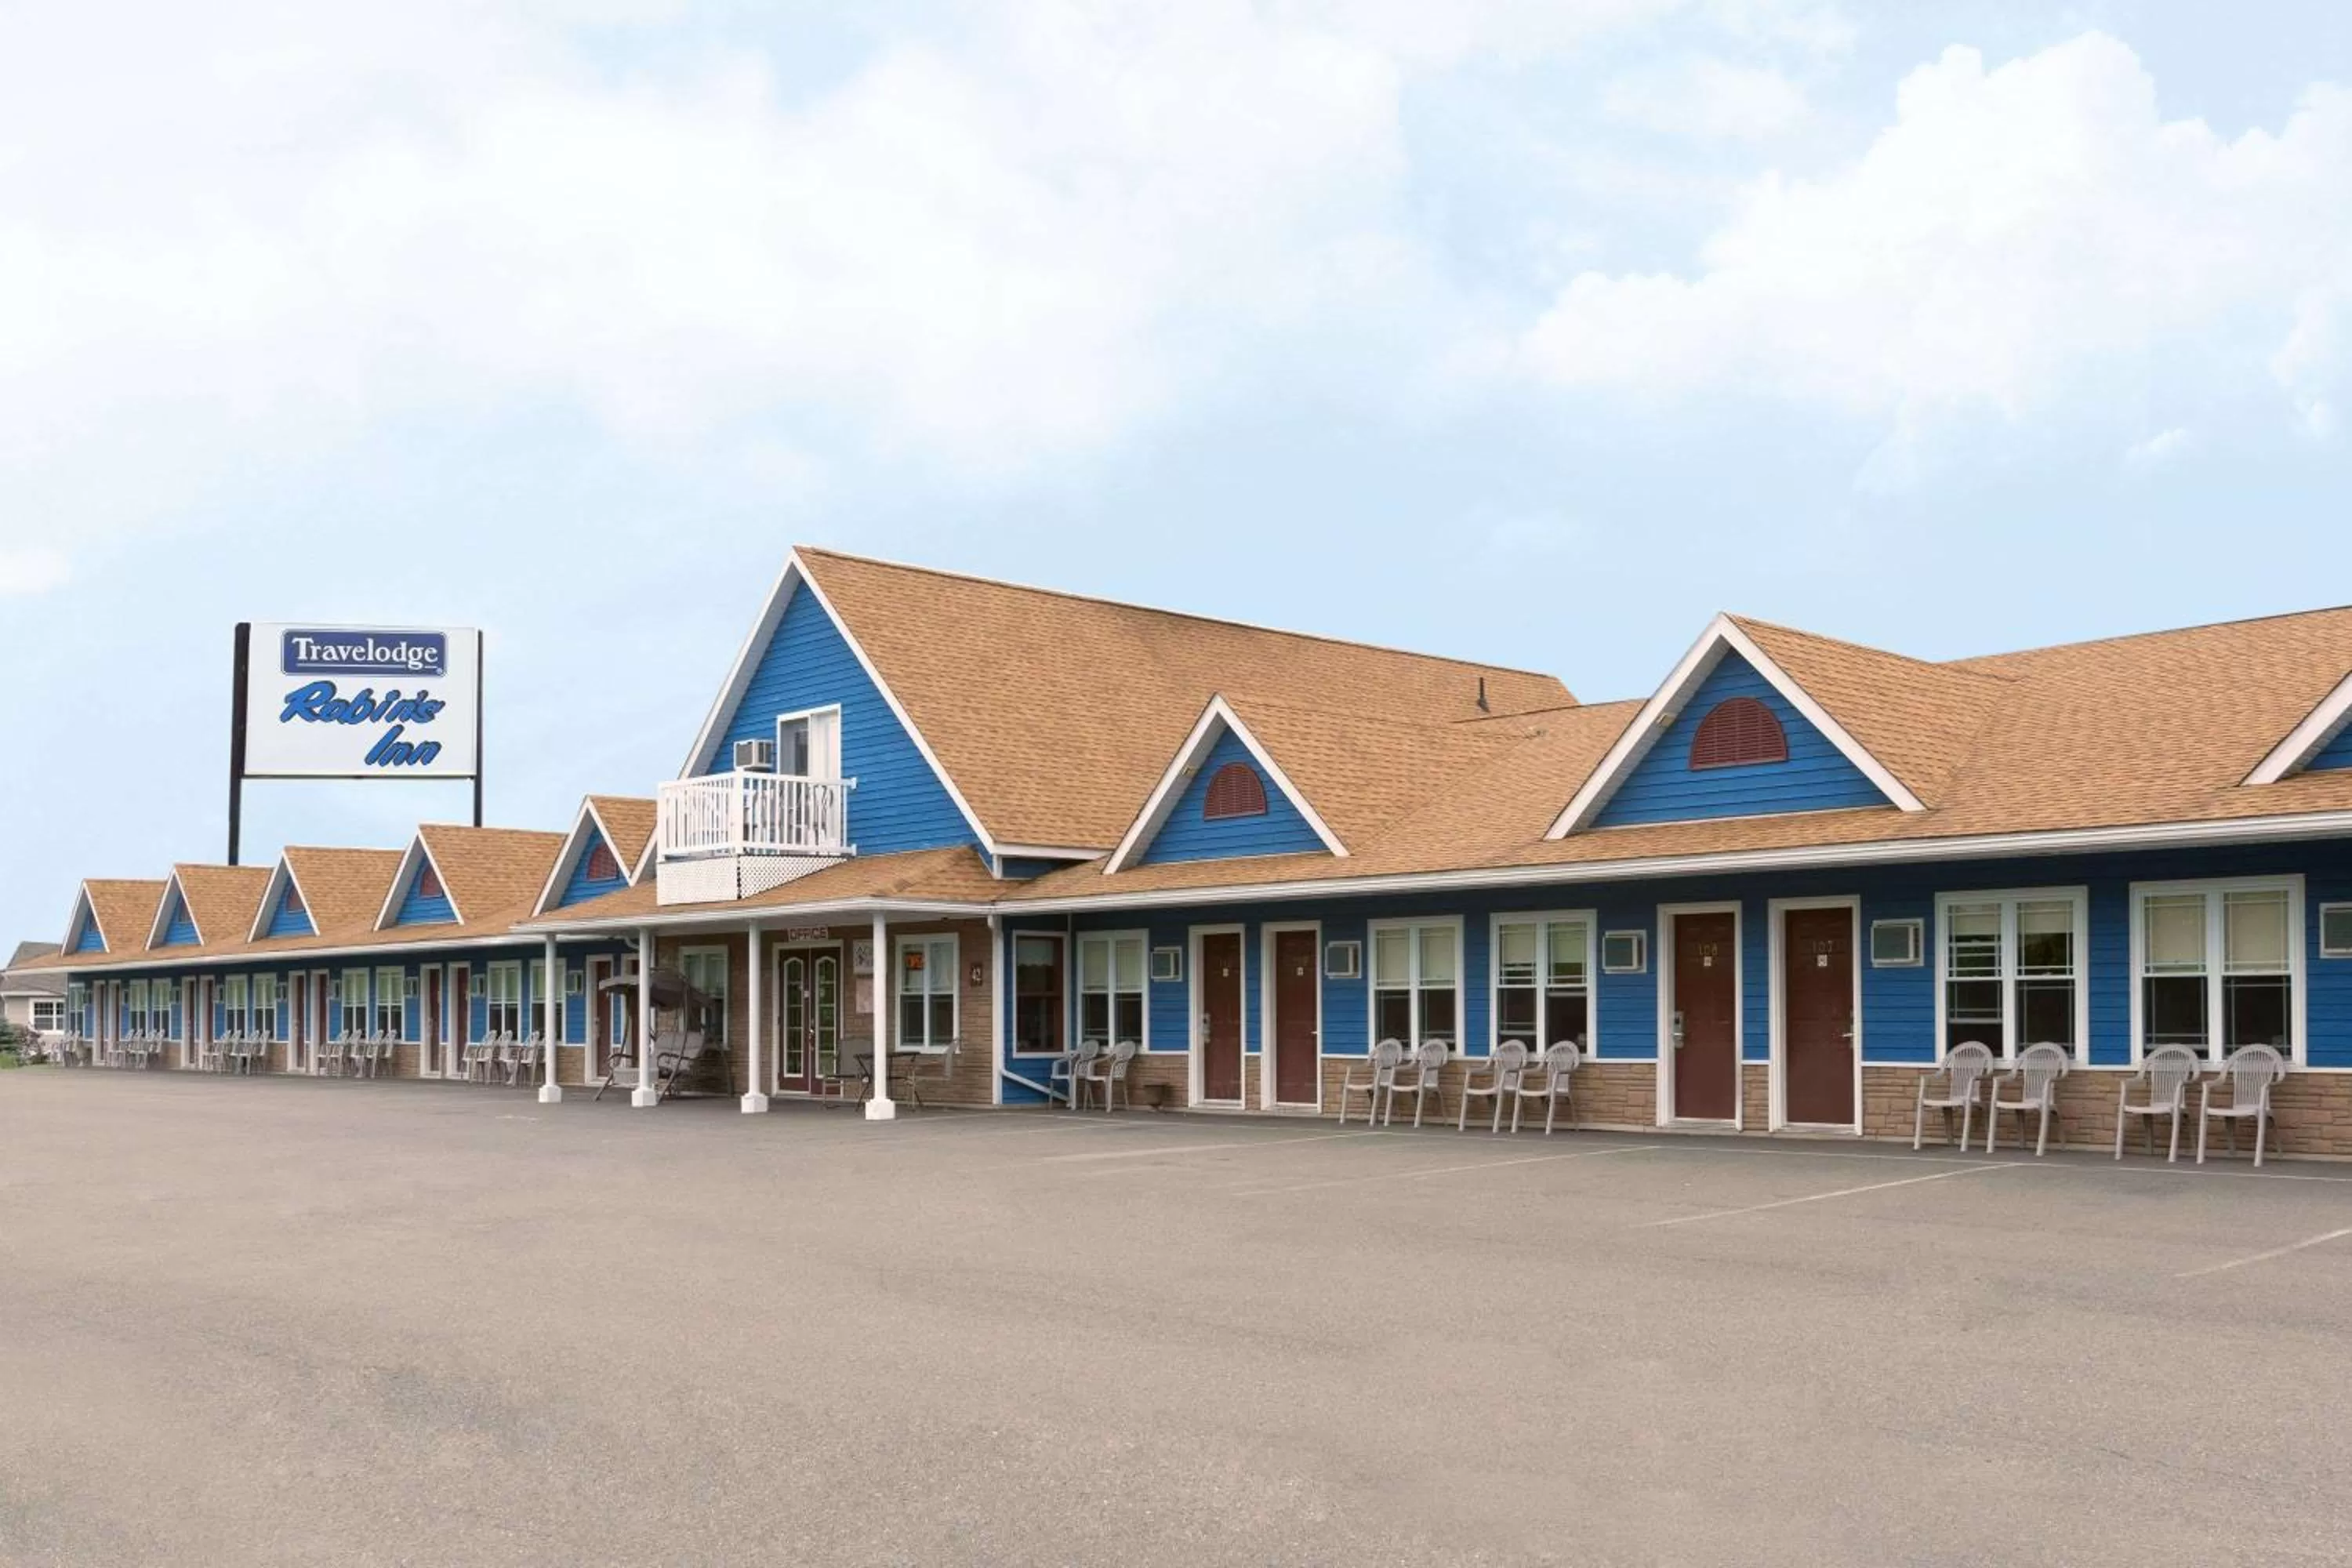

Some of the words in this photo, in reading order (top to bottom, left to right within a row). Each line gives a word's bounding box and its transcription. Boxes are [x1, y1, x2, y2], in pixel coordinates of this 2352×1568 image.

[292, 637, 438, 670] Travelodge
[280, 680, 445, 724] Robin's
[365, 724, 441, 766] Inn
[789, 927, 827, 940] OFFICE
